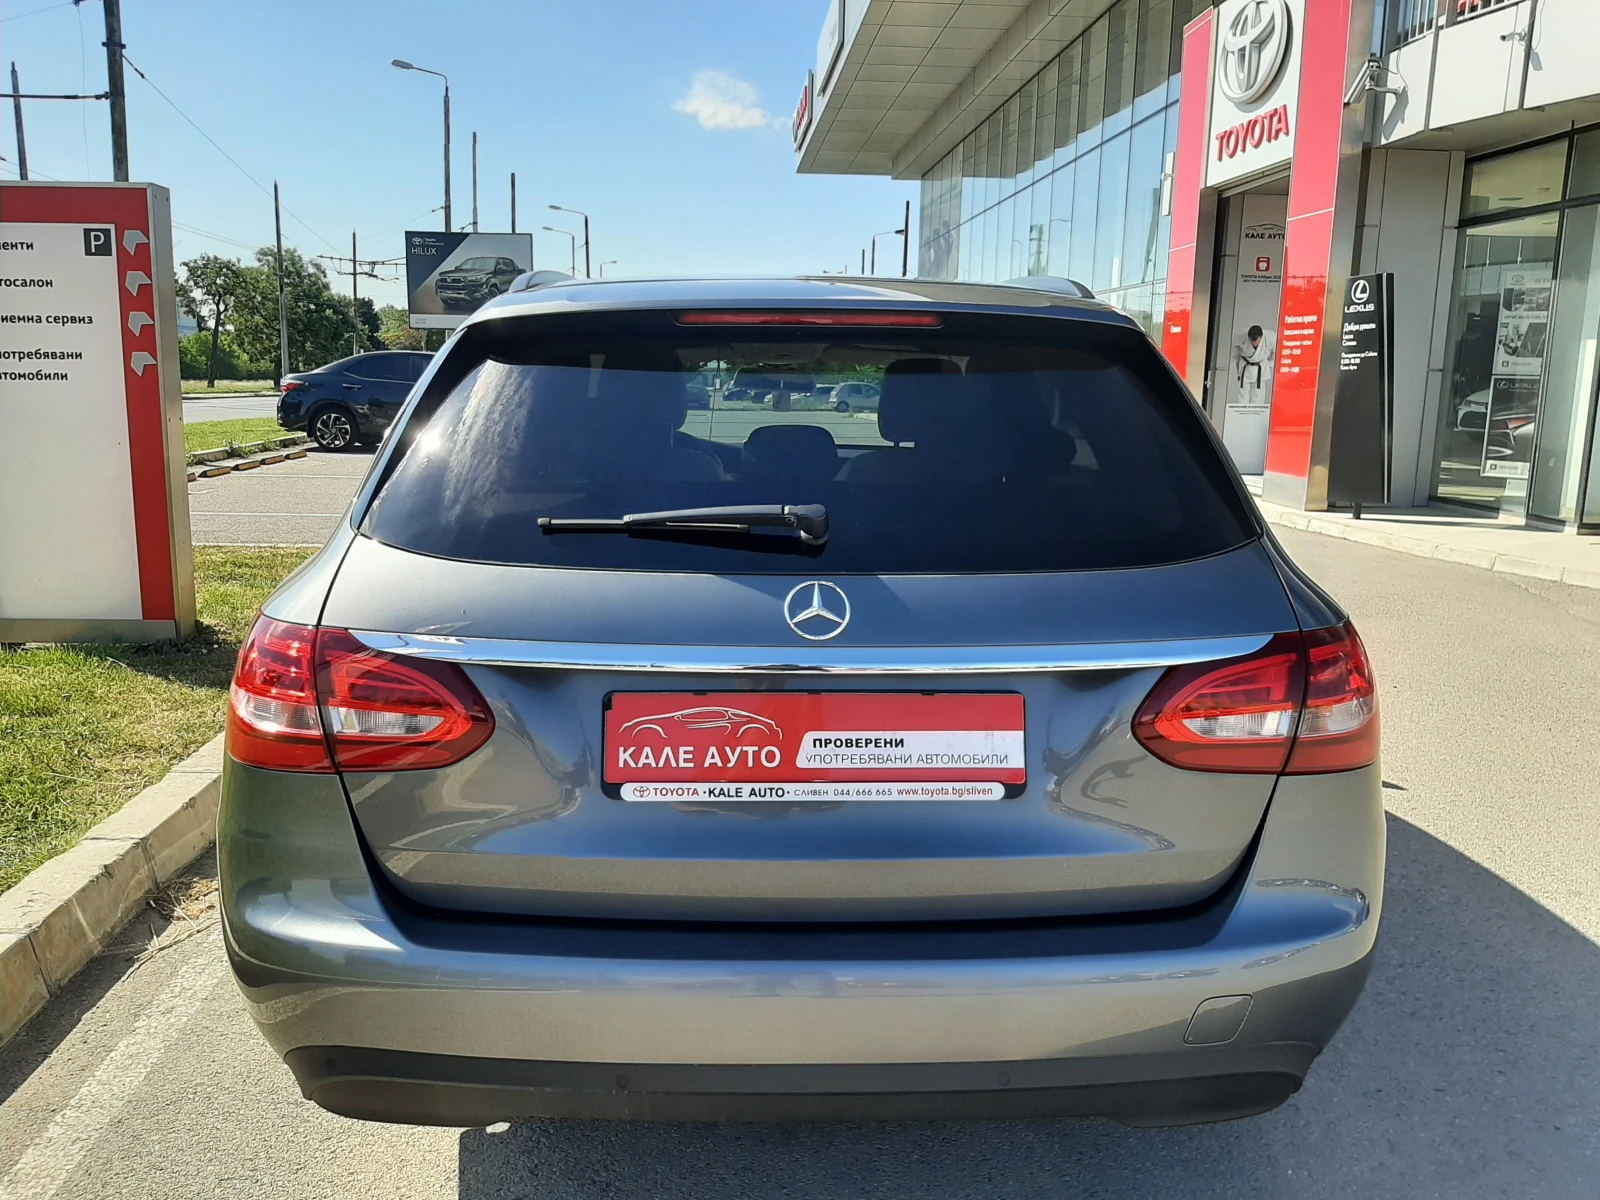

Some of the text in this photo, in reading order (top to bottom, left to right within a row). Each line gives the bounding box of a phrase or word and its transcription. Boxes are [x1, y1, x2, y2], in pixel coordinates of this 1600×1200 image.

[1215, 104, 1289, 162] TOYOTA
[90, 231, 105, 253] P
[411, 246, 437, 255] HILUX
[1344, 303, 1375, 313] LEXUS
[46, 315, 94, 327] сервиз
[0, 348, 83, 362] отребявани
[0, 369, 68, 381] томобили
[812, 738, 905, 748] ПРОВЕРЕНИ
[618, 746, 782, 768] КАЛЕ АУТО
[806, 753, 1009, 765] УПОТРЕБЯВАНИ АВТОМОБИЛИ
[652, 788, 700, 797] TOYOTA
[833, 788, 873, 797] 044/666
[875, 788, 893, 797] 665
[897, 785, 993, 799] www.toyota.bg/sliven
